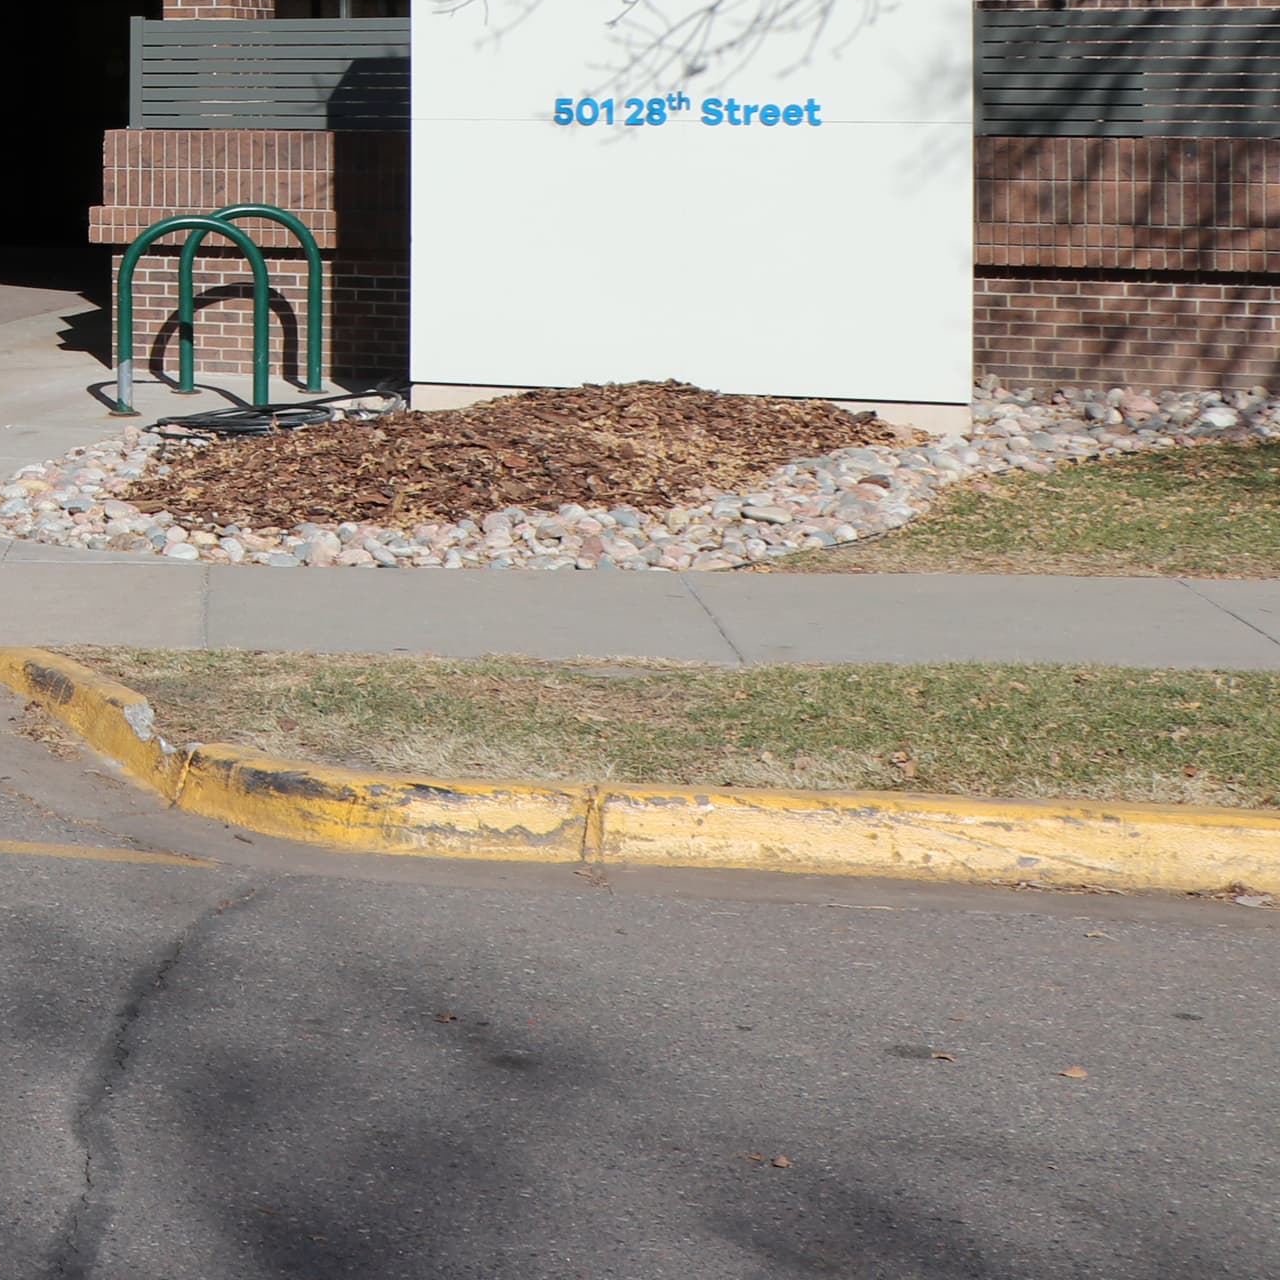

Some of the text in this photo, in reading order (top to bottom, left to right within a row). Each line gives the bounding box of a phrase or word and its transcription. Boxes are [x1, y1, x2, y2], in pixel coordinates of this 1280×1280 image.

[553, 91, 821, 126] 501 28th Street
